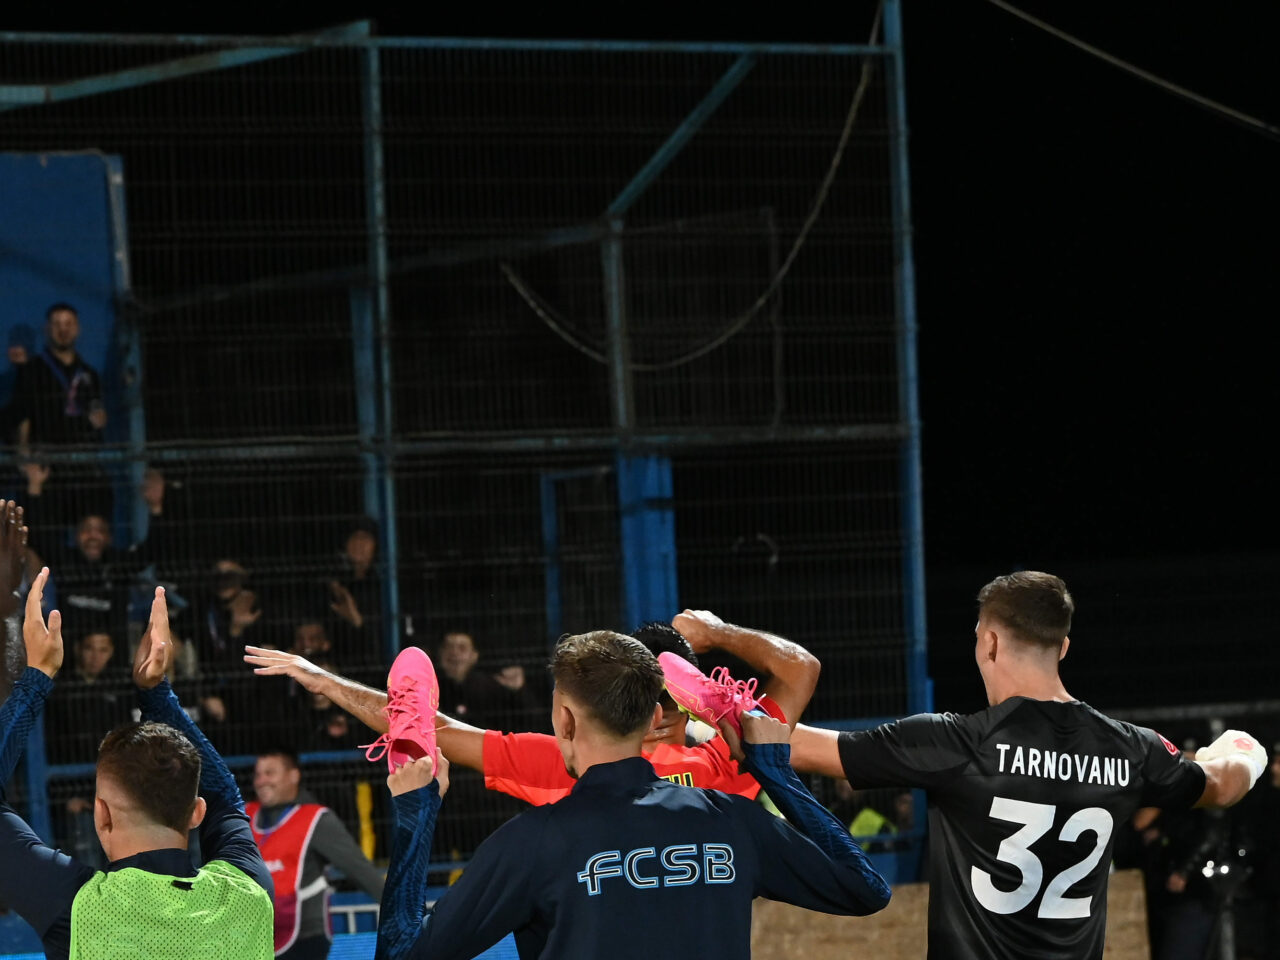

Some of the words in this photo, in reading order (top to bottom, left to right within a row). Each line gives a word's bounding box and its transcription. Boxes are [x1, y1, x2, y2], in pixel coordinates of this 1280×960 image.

[996, 743, 1130, 787] TARNOVANU
[577, 843, 736, 896] FCSB
[971, 796, 1114, 919] 32
